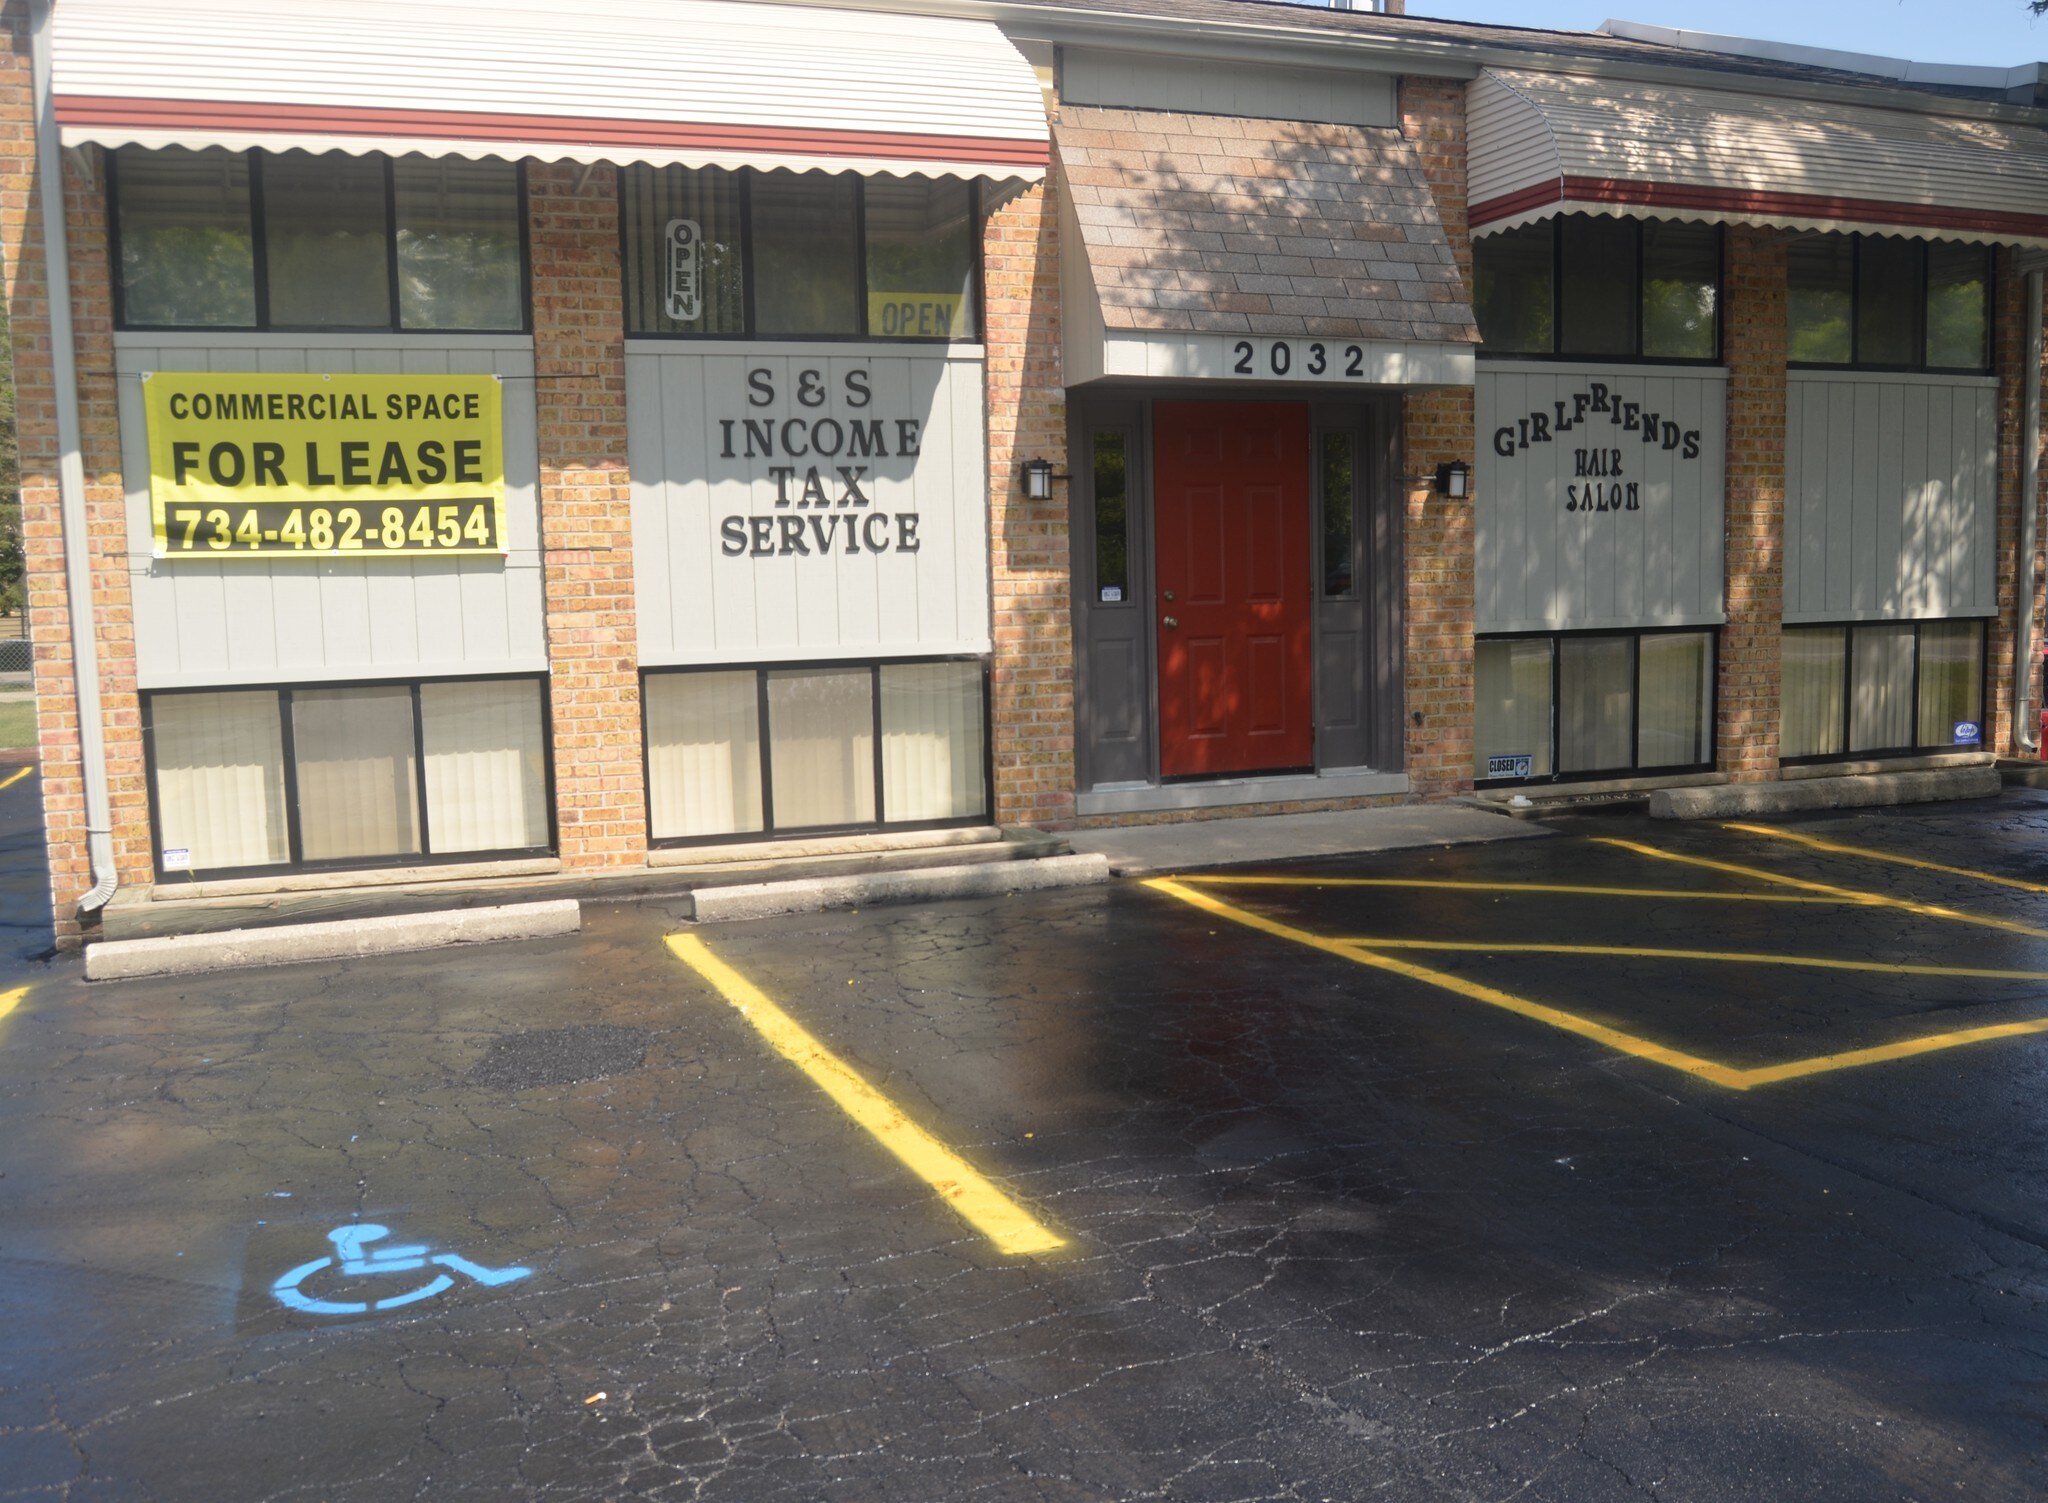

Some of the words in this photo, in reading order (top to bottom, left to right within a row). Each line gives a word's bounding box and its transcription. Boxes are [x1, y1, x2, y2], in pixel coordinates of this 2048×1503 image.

[673, 224, 693, 315] OPEN
[881, 302, 952, 335] OPEN
[1234, 341, 1364, 377] 2032
[169, 392, 378, 420] COMMERCIAL
[386, 393, 480, 419] SPACE
[748, 368, 775, 407] S
[797, 369, 826, 407] &
[845, 369, 872, 407] S
[719, 418, 921, 458] INCOME
[1493, 382, 1700, 460] GIRLFRIENDS
[172, 441, 289, 487] FOR
[305, 440, 483, 486] LEASE
[1574, 448, 1624, 477] HAIR
[768, 465, 870, 508] TAX
[1566, 482, 1640, 512] SALON
[174, 504, 490, 550] 734-482-8454
[720, 512, 921, 557] SERVICE
[1489, 759, 1515, 773] CLOSED
